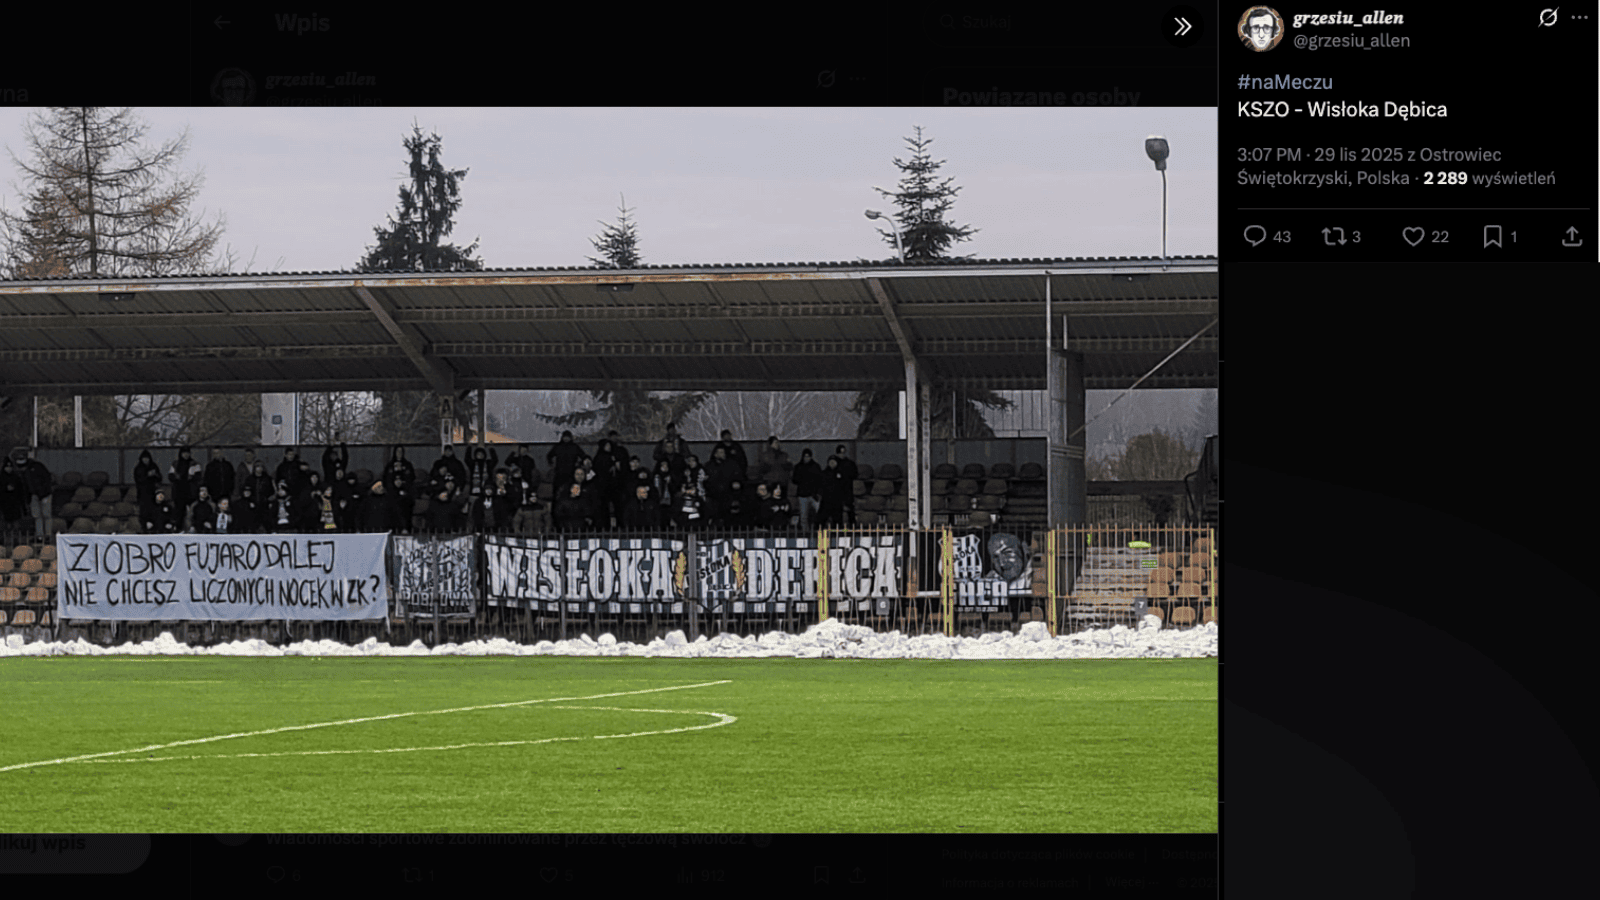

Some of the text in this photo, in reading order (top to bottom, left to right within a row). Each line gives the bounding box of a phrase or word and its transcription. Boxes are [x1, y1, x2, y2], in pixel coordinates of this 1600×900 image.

[275, 13, 330, 35] Wpis
[963, 14, 1011, 31] Szukaj
[1293, 9, 1405, 29] grzesiu_allen
[1293, 32, 1411, 51] @grzesiu_allen
[265, 72, 376, 90] grzesiu_allen
[1237, 73, 1333, 90] #naMeczu
[0, 88, 29, 102] na
[1238, 100, 1290, 118] KSZO
[1307, 100, 1380, 118] Wisłoka
[1384, 100, 1448, 122] Dębica
[1237, 146, 1502, 162] 3:07 PM 29 lis 2025 z Ostrowiec
[1237, 167, 1353, 188] Świętokrzyski,
[1357, 169, 1410, 185] Polska
[1471, 169, 1556, 188] wyświetleń
[1272, 230, 1292, 243] 43
[1352, 230, 1361, 243] 3
[1431, 230, 1450, 243] 22
[1510, 230, 1517, 243] 1
[68, 539, 335, 576] ZIOBRO FUJARO DALEJ
[64, 578, 98, 607] NIE
[106, 578, 180, 607] CHCESZ
[189, 577, 275, 607] LICZONYCH
